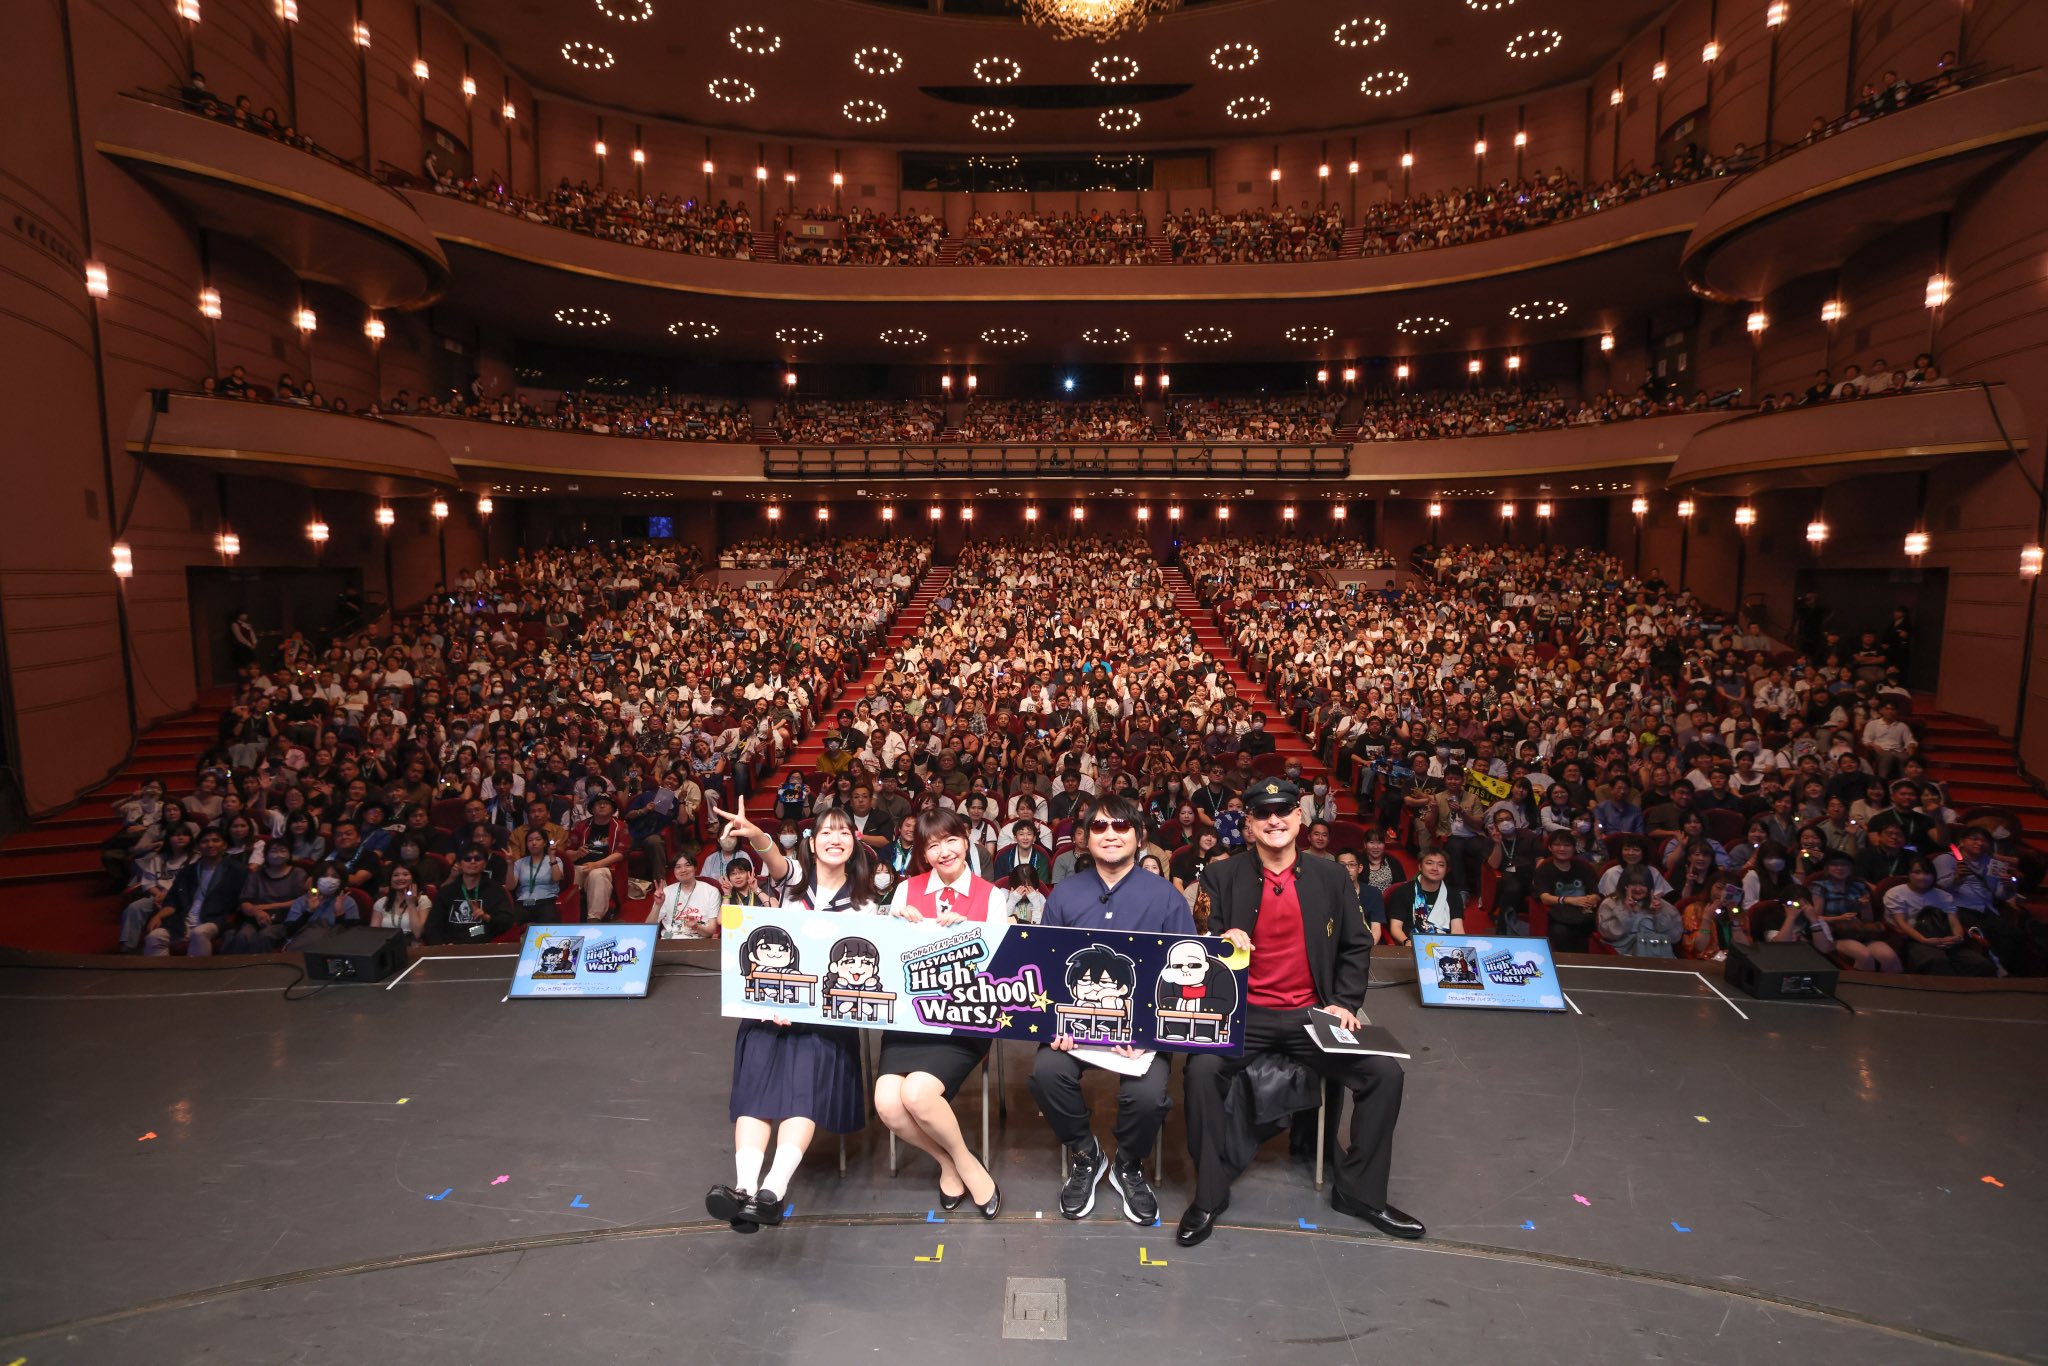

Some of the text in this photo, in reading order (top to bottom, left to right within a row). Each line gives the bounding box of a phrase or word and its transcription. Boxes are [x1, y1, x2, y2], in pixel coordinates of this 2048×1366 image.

[587, 949, 609, 960] High
[602, 950, 632, 963] school
[909, 945, 979, 972] WASYAGANA
[589, 963, 617, 971] Wars!
[1487, 961, 1510, 971] High
[1504, 963, 1536, 976] school
[911, 961, 971, 990] High
[1492, 974, 1522, 983] Wars!
[953, 970, 1036, 1003] school
[919, 999, 998, 1025] Wars!
